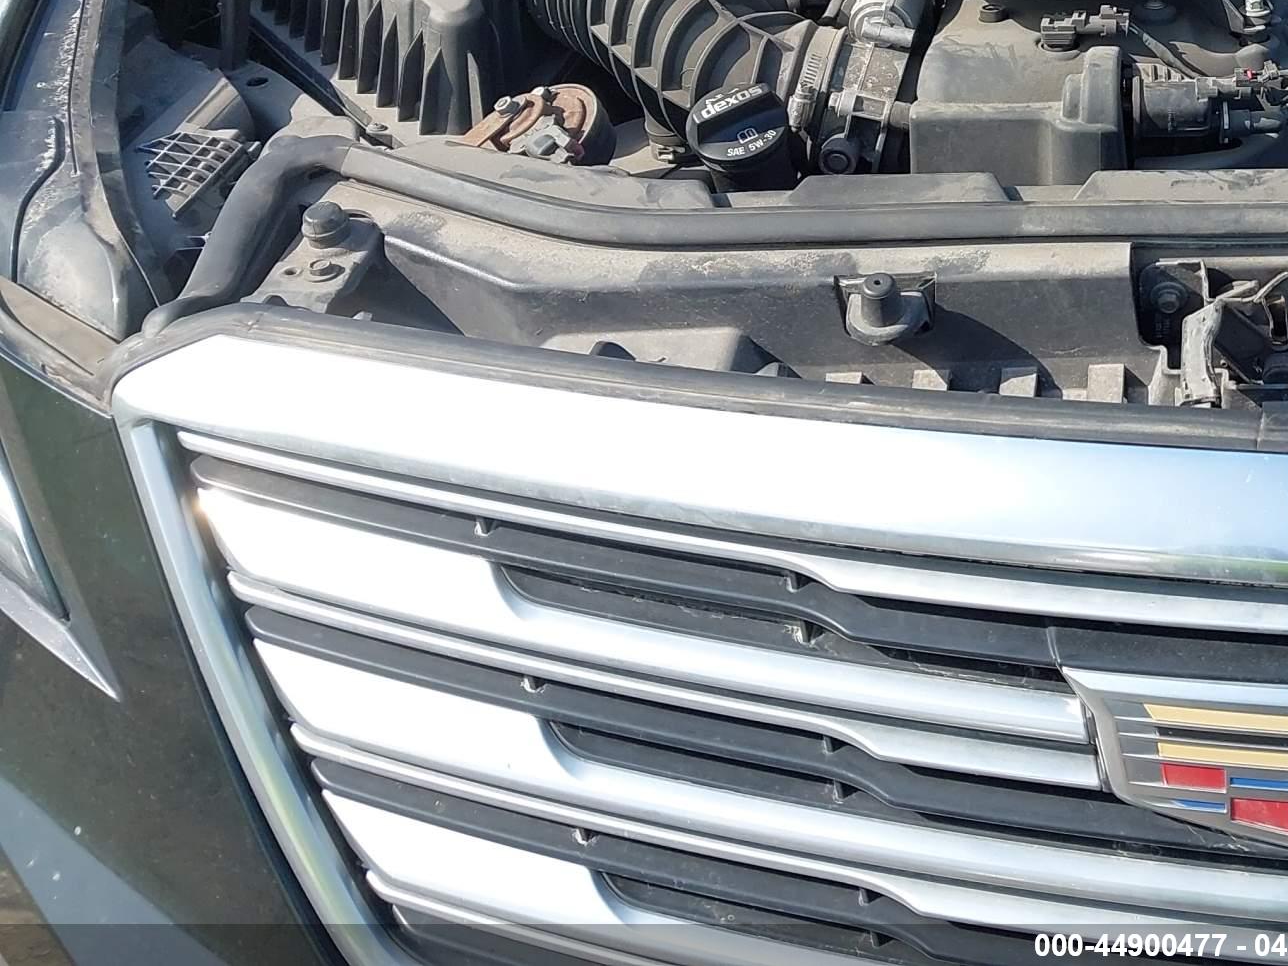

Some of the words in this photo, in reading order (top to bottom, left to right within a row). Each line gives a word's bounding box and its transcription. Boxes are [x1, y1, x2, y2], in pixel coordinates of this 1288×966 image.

[701, 85, 763, 119] dexos
[726, 146, 746, 157] SAE
[748, 129, 777, 152] 5W-30
